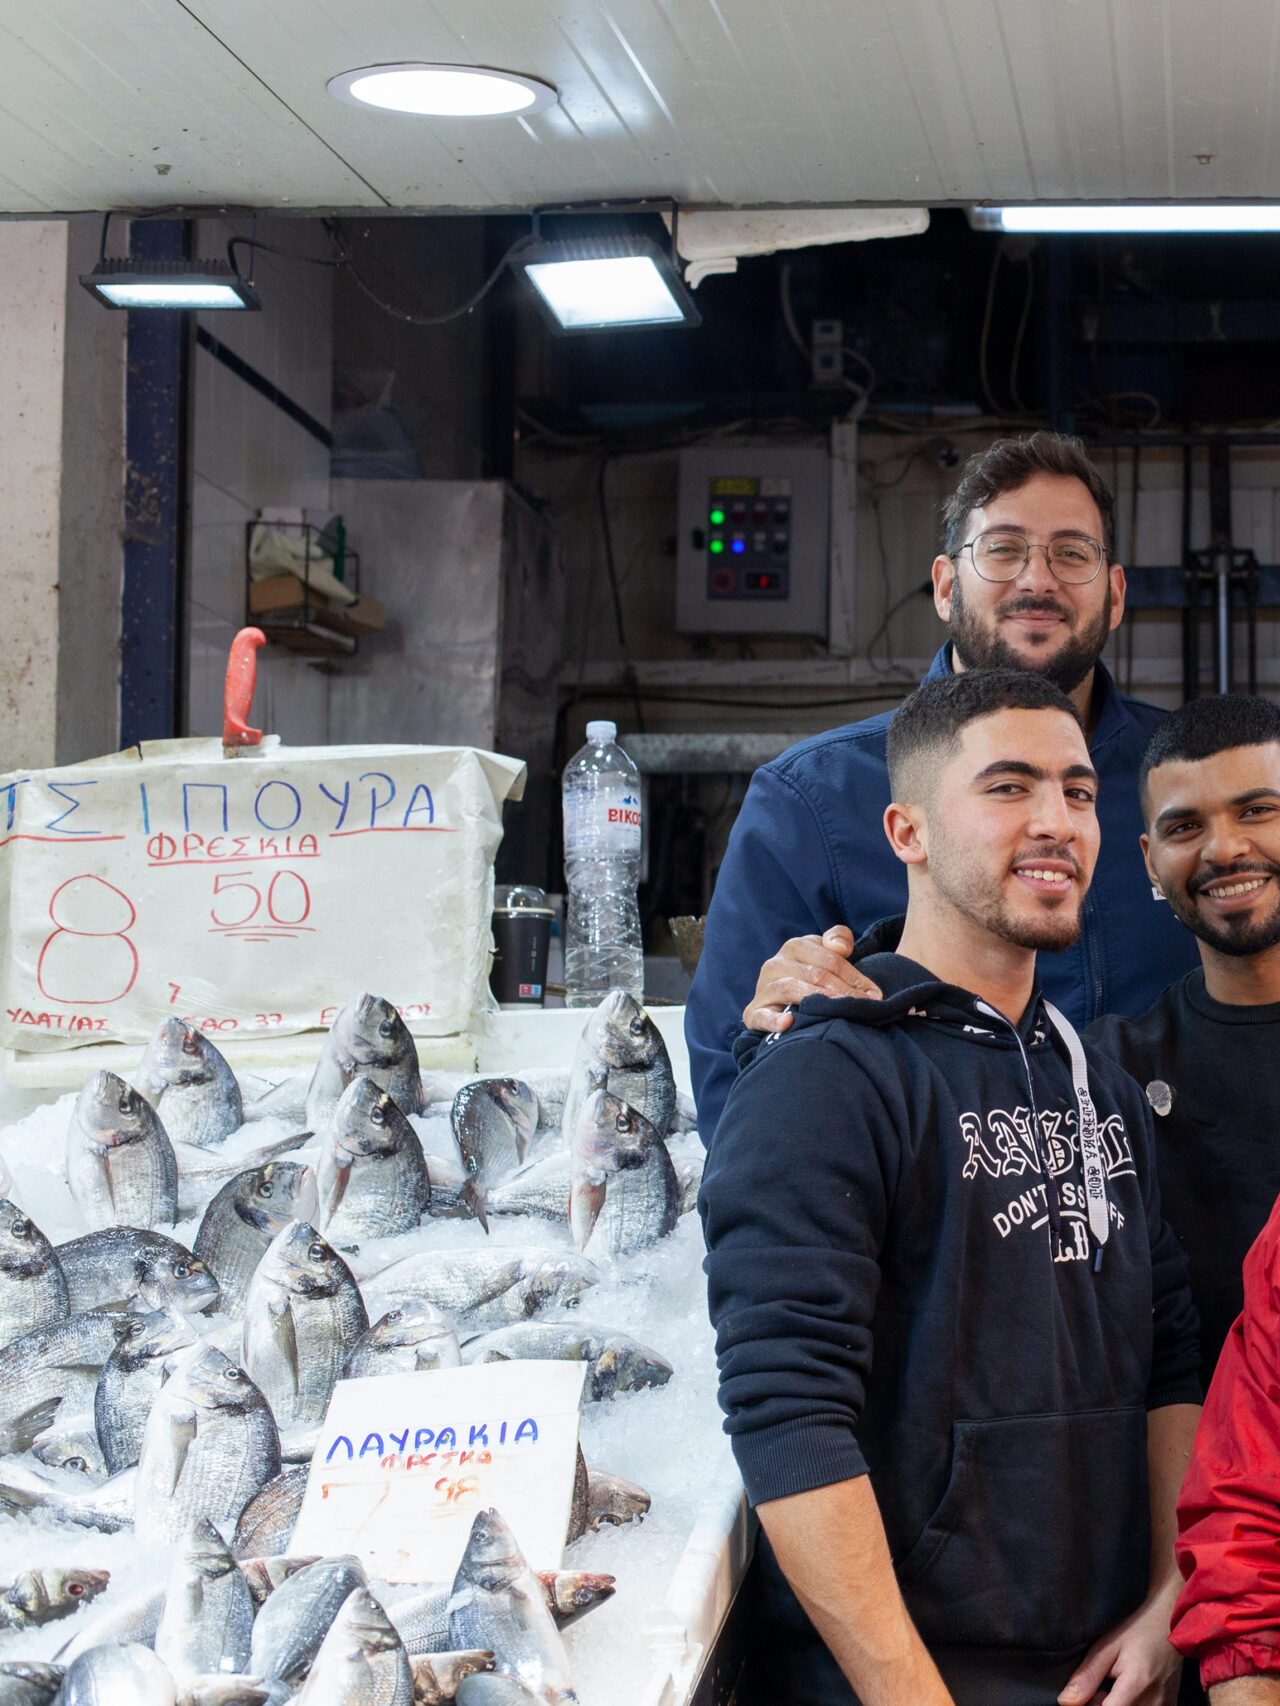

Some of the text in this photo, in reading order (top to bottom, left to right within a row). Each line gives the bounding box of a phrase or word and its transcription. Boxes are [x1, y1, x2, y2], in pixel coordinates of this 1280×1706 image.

[0, 772, 435, 835] ΤΣΙΠΟΥΡΑ
[146, 832, 319, 861] ΦΡΕΣΚΙΑ
[210, 870, 311, 927] 50
[37, 873, 140, 1004] 8
[326, 1418, 539, 1463] ΛΑΥΡΑΚΙΑ
